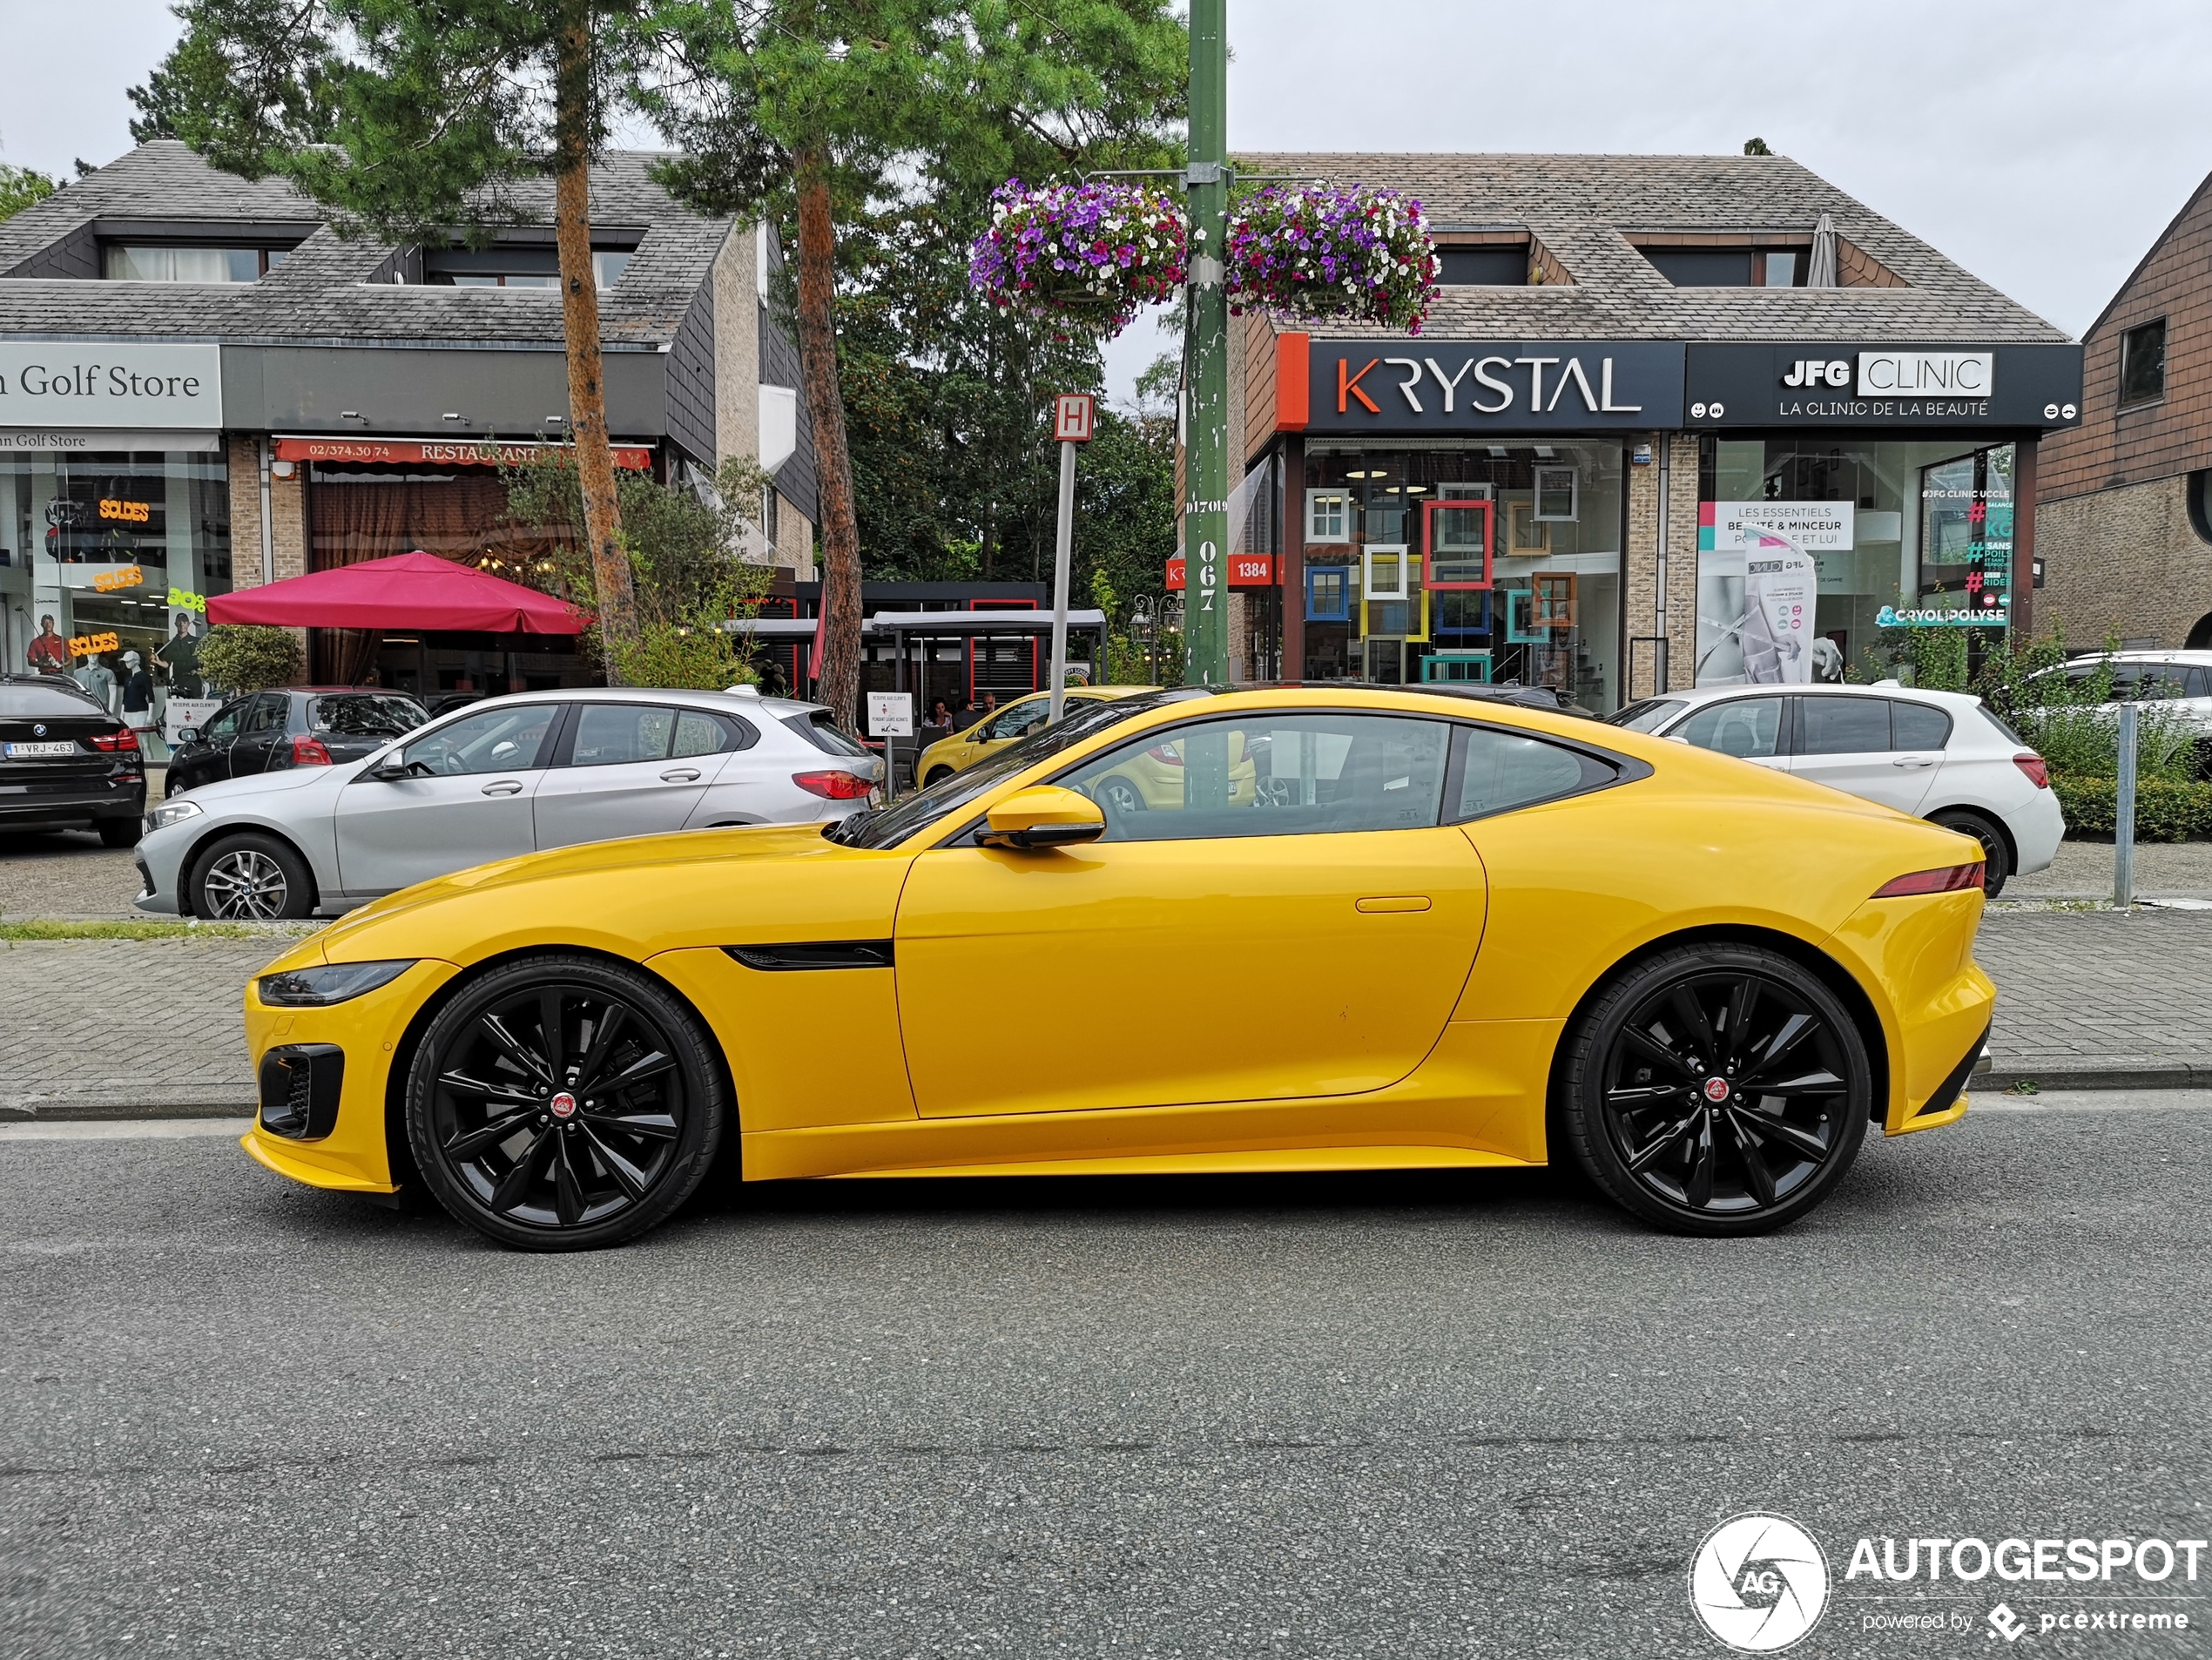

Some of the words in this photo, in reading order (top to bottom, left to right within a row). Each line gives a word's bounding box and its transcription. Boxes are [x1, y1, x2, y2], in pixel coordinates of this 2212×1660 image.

[20, 364, 101, 396] Golf
[109, 366, 200, 397] Store
[1784, 360, 1850, 387] JFG
[1868, 359, 1982, 389] CLINIC
[1337, 356, 1642, 414] KRYSTAL
[1064, 401, 1083, 431] H
[1779, 402, 1802, 415] LA
[1806, 402, 1868, 415] CLINIC
[1872, 402, 1894, 415] DE
[1899, 402, 1921, 415] LA
[1925, 399, 1988, 416] BEAUTÉ
[16, 434, 47, 447] Golf
[50, 434, 86, 447] Store
[421, 445, 539, 462] RESTAURANT
[1947, 489, 1978, 498] CLINIC
[1979, 489, 2010, 498] UCCLE
[99, 498, 150, 523] SOLDES
[1738, 508, 1760, 517] LES
[1763, 508, 1831, 517] ESSENTIELS
[1728, 519, 1774, 530] BETÉ
[1777, 522, 1785, 530] &
[1789, 521, 1842, 530] MINCEUR
[1986, 521, 2013, 537] KG
[1802, 534, 1817, 543] ET
[1819, 534, 1838, 543] LUI
[1986, 542, 2011, 550] SANS
[1238, 562, 1267, 577] 1384
[92, 565, 144, 593] SOLDES
[1983, 577, 2012, 586] RIDES
[166, 587, 206, 614] 30%
[68, 631, 118, 658] SOLDES
